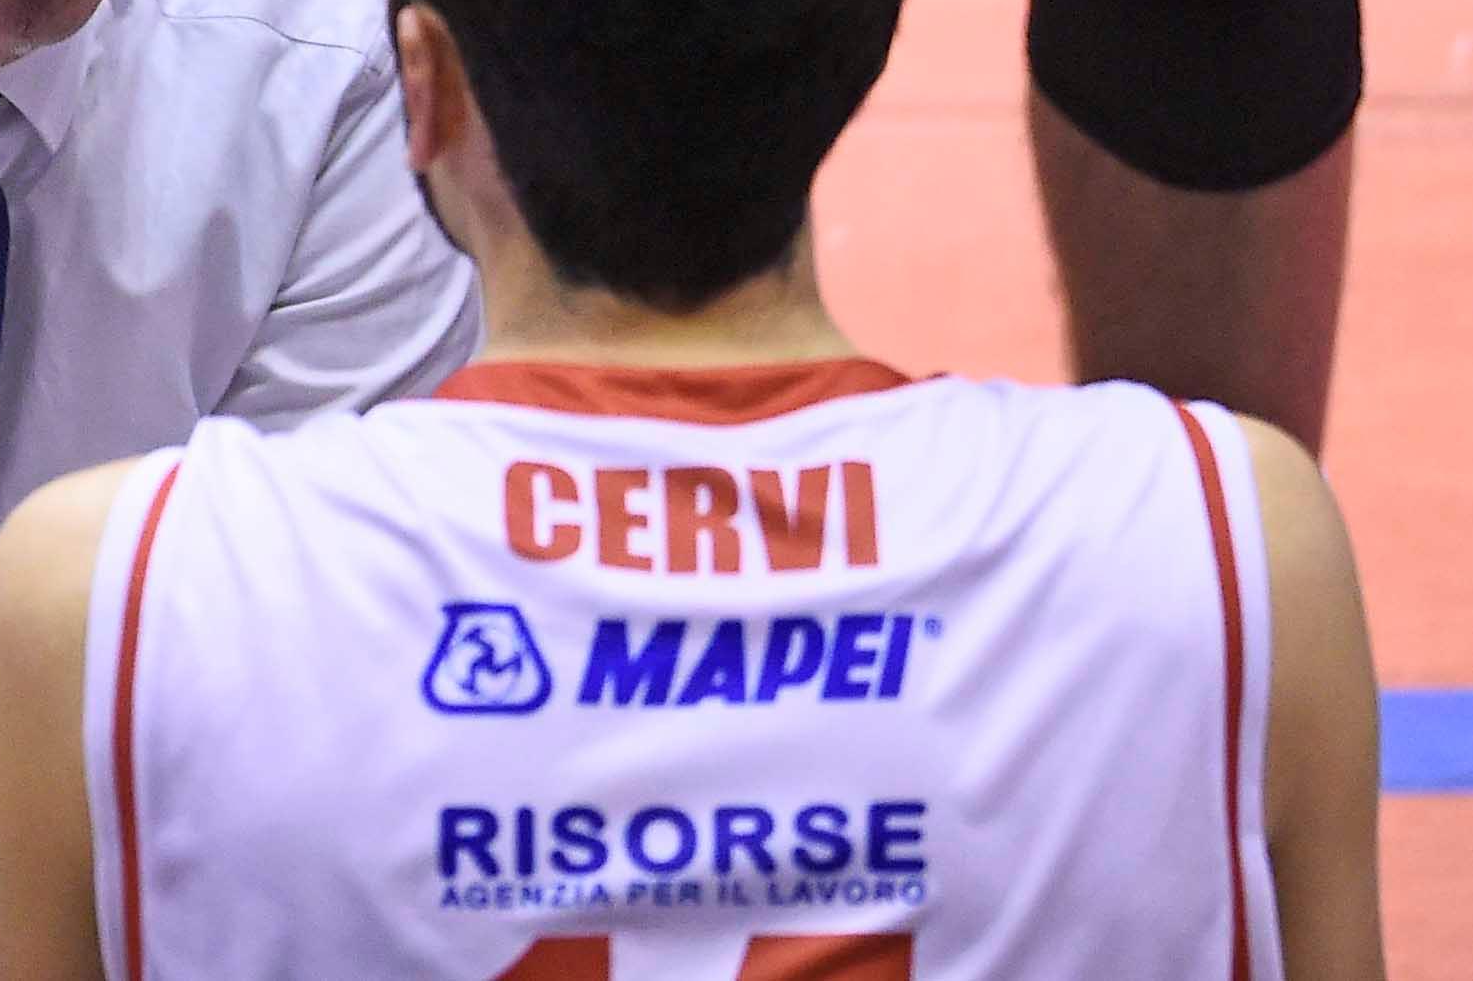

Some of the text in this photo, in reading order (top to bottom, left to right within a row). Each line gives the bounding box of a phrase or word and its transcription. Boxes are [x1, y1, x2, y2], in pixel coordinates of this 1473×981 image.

[503, 460, 879, 574] CERVI
[576, 614, 916, 707] MAPEI
[438, 801, 928, 878] RISORSE
[439, 875, 928, 910] AGENZIA PER IL LAVORO
